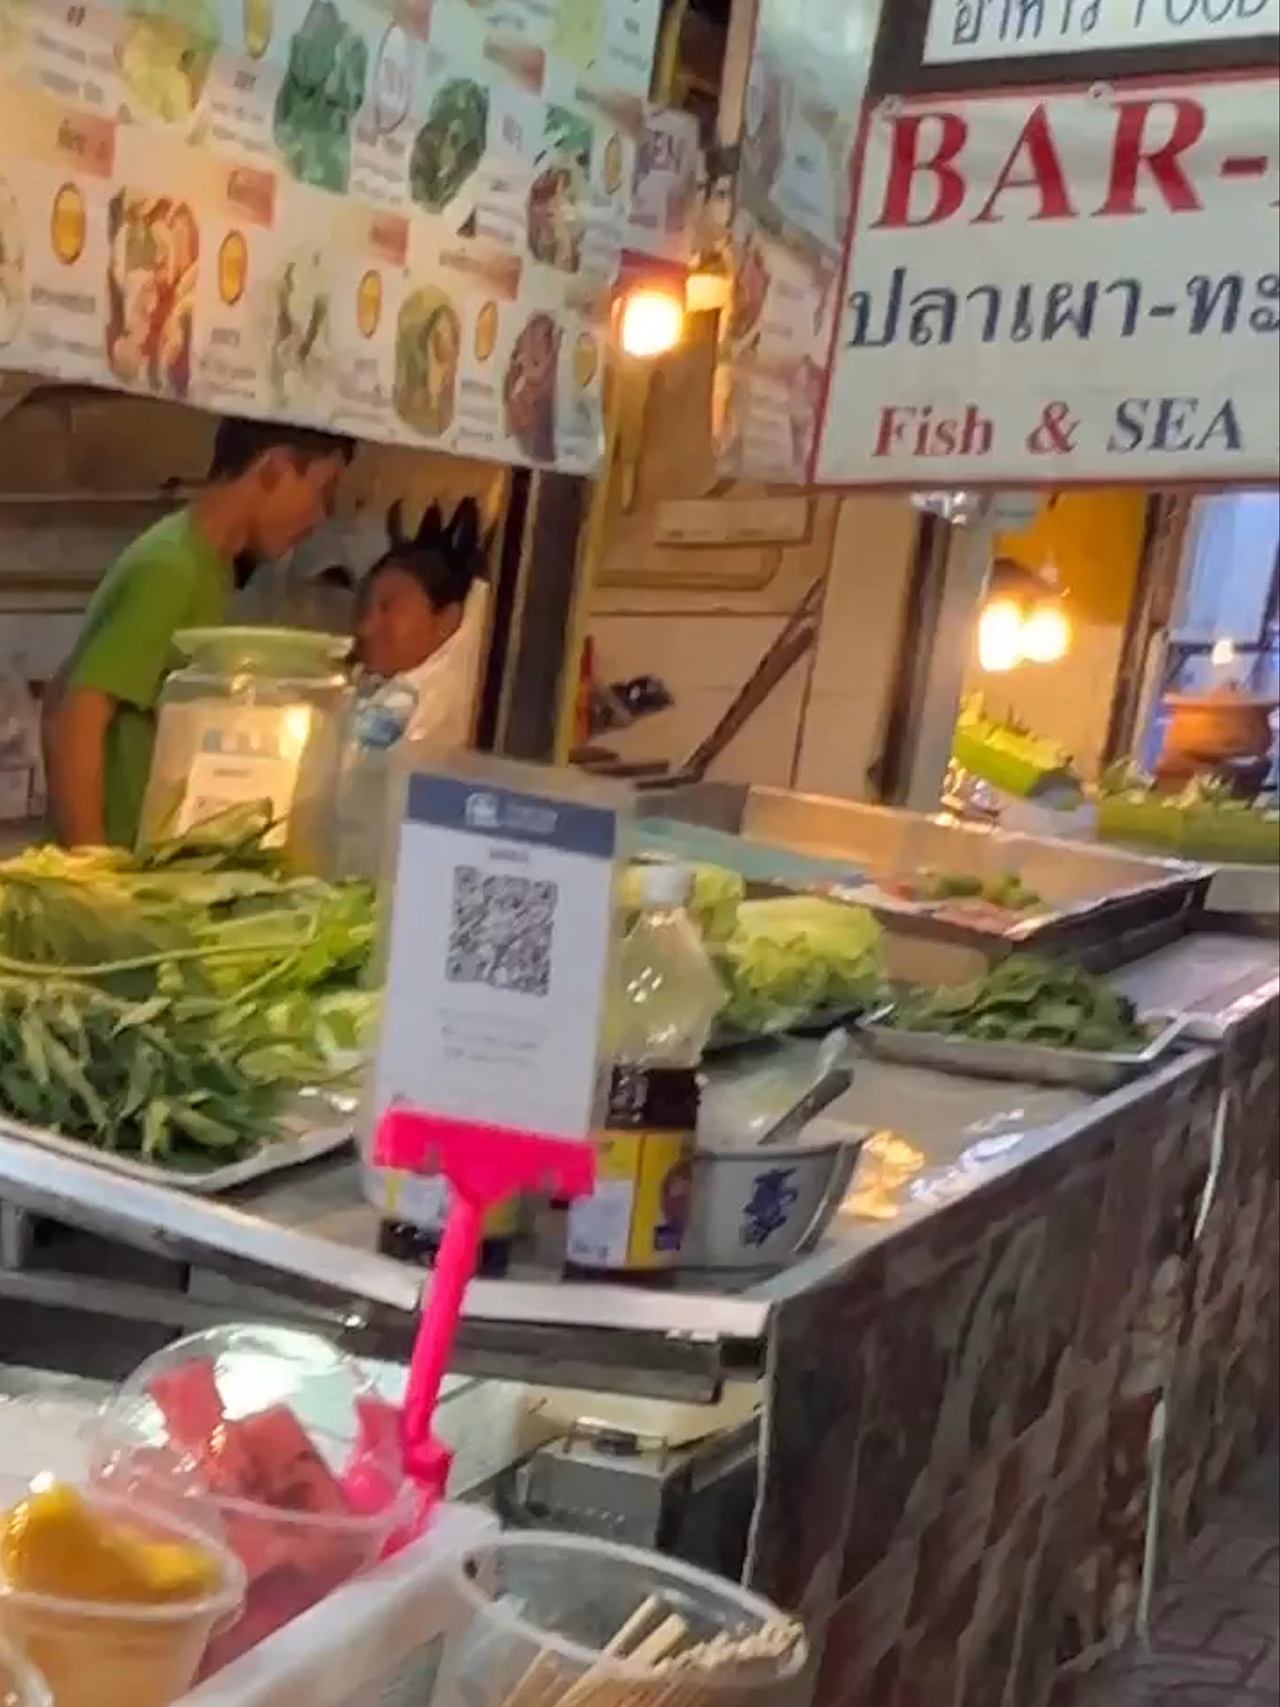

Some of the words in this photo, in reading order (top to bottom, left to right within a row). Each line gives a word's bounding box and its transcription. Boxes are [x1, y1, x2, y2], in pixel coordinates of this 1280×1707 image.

[868, 97, 1280, 230] BAR-
[871, 403, 996, 457] Fish
[1025, 400, 1082, 456] &
[1105, 396, 1245, 454] SEA
